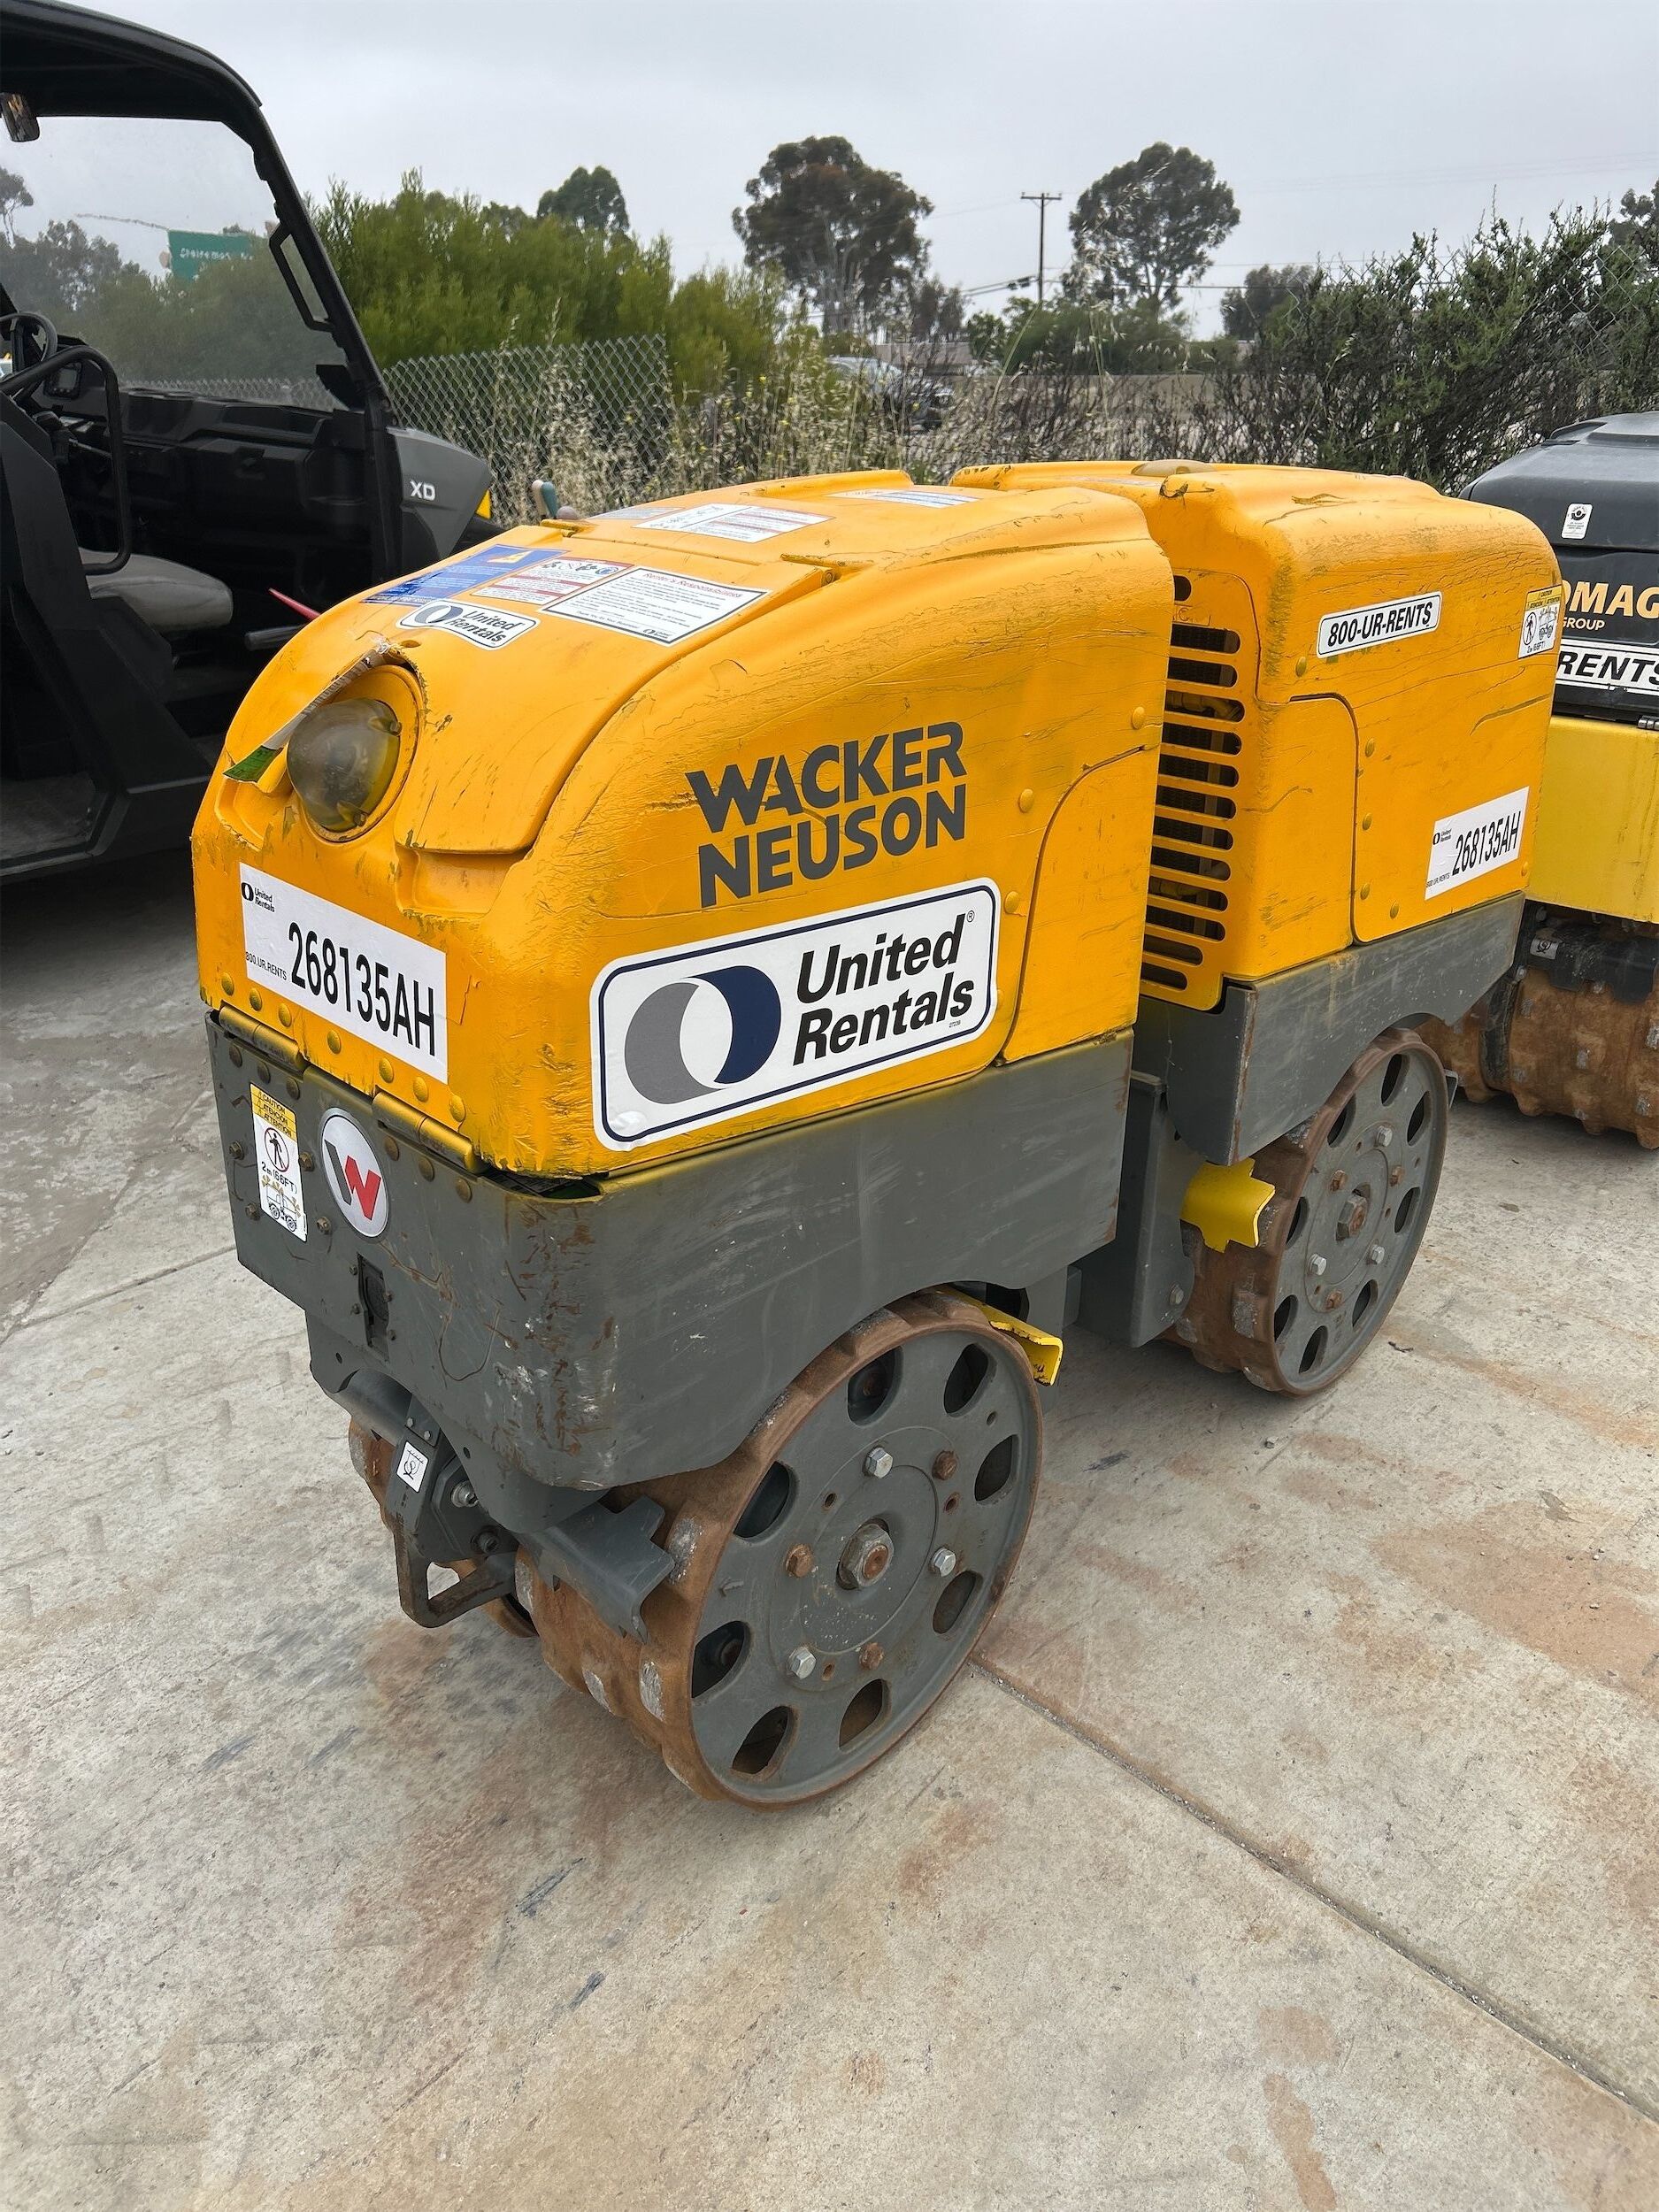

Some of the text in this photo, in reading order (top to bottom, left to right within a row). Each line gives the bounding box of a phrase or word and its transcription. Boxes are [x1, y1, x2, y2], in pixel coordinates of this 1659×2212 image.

[410, 480, 435, 501] XD
[444, 618, 507, 642] Rentals
[462, 611, 523, 631] United
[1327, 602, 1432, 647] 800-UR-RENTS
[684, 721, 967, 833] WACKER
[699, 784, 966, 908] NEUSON
[1452, 810, 1521, 877] 268135AH
[254, 887, 273, 902] United
[255, 896, 275, 912] Rentals
[796, 913, 966, 1003] United
[288, 922, 434, 1056] 268135AH
[793, 972, 975, 1066] Rentals
[263, 1094, 286, 1115] CAUTION
[264, 1113, 293, 1138] ATTENTION
